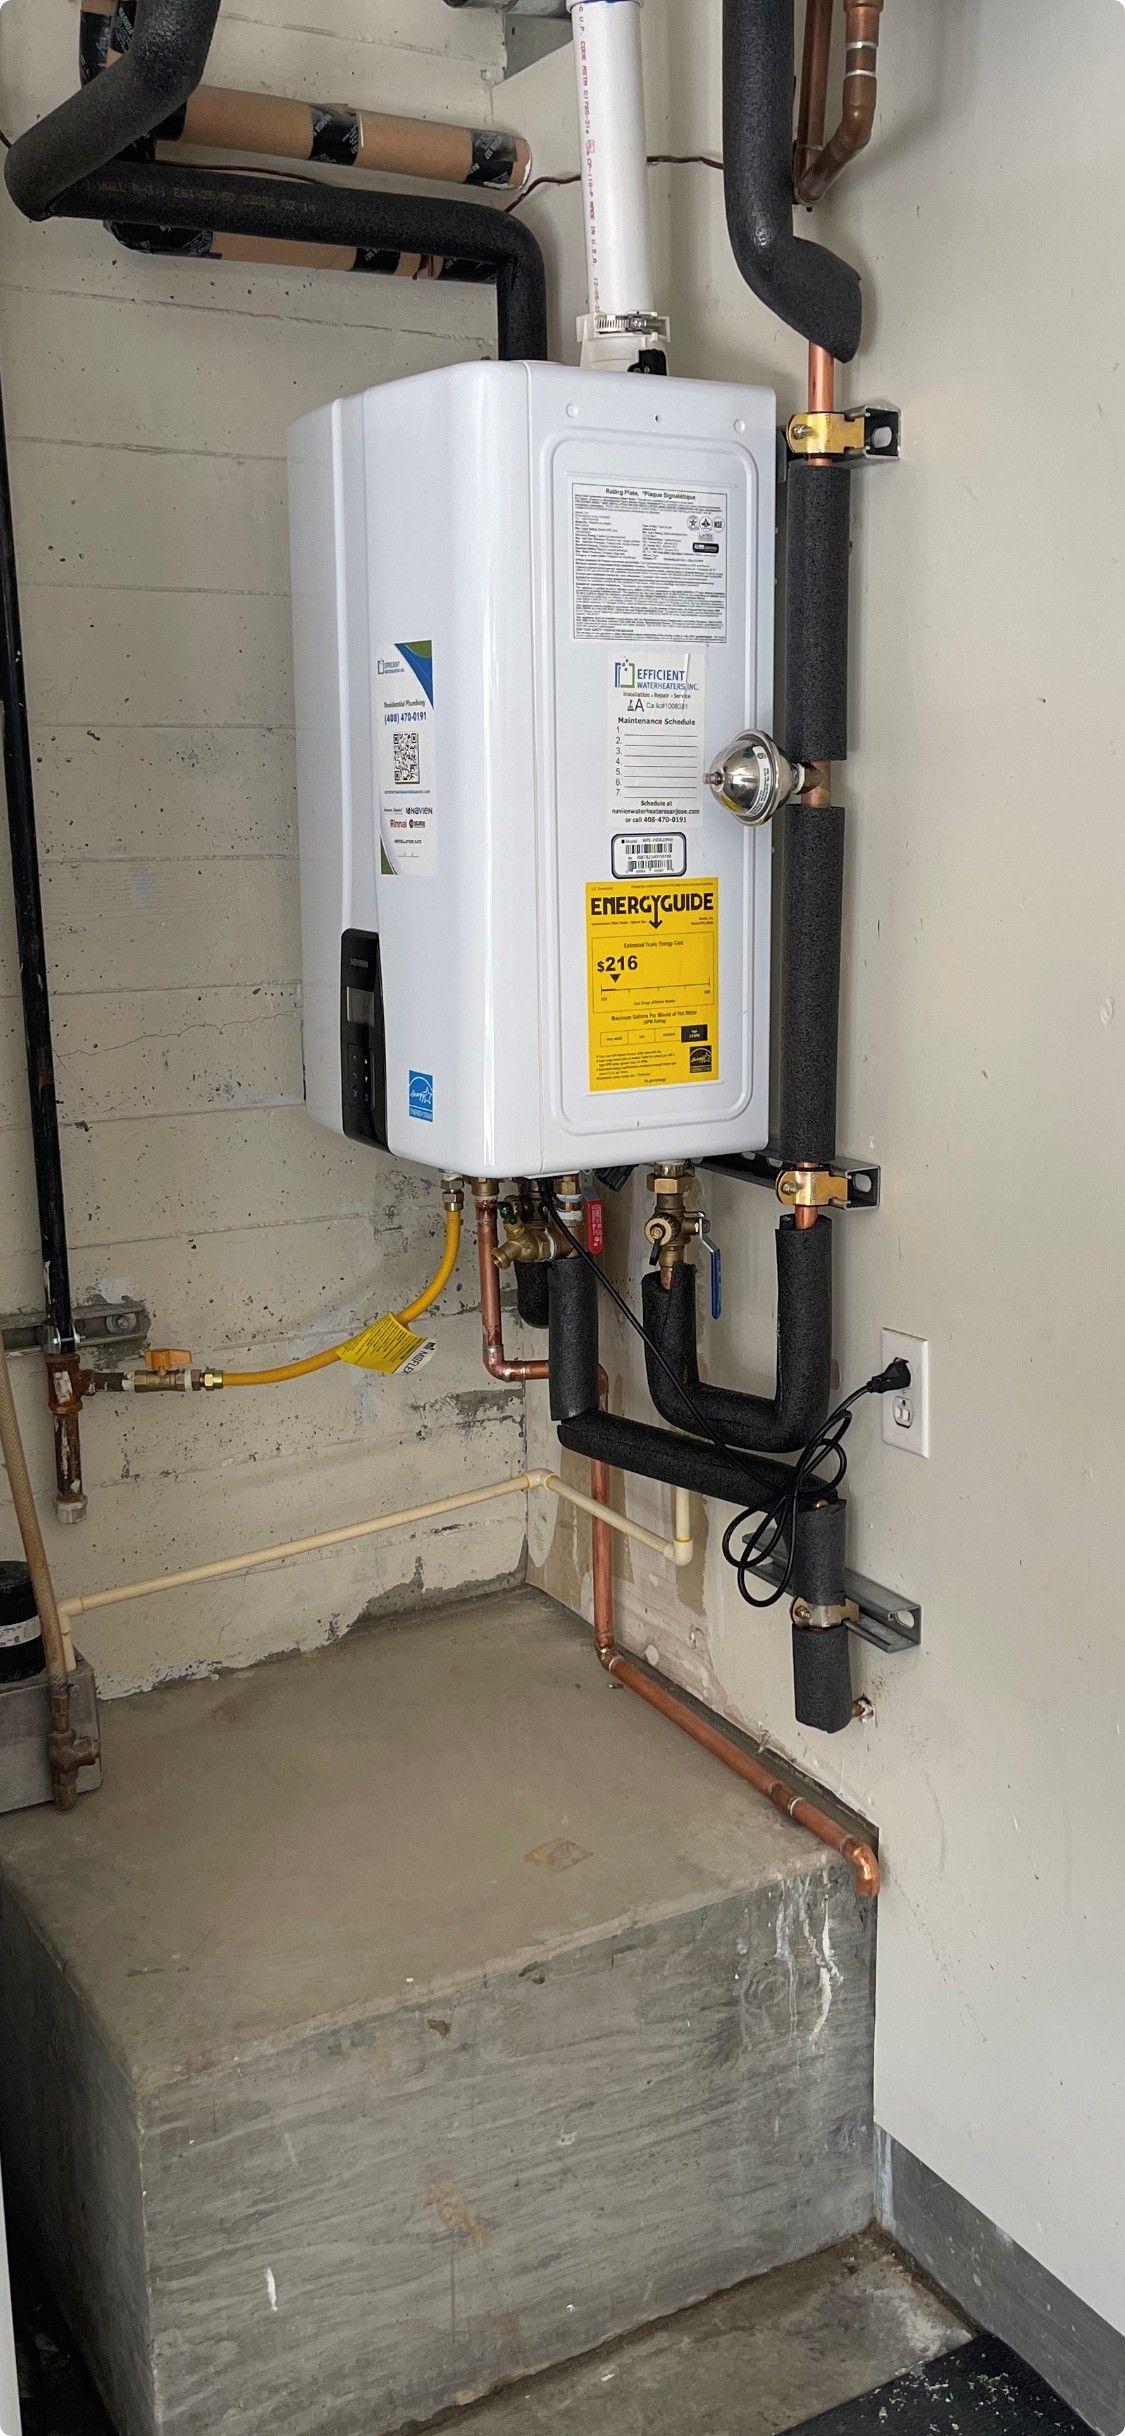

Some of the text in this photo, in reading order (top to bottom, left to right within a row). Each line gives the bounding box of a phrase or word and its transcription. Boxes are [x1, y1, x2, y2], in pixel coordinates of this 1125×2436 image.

[580, 41, 588, 61] CODE
[590, 226, 596, 235] IN
[605, 488, 623, 496] Rating
[637, 669, 685, 681] EFFICIENT
[384, 699, 425, 708] Residential Plumbing
[384, 711, 427, 725] (408) 470-0191
[618, 717, 696, 726] Maintenance Schedule
[591, 893, 714, 919] ENERGYGUIDE
[597, 955, 638, 973] $216
